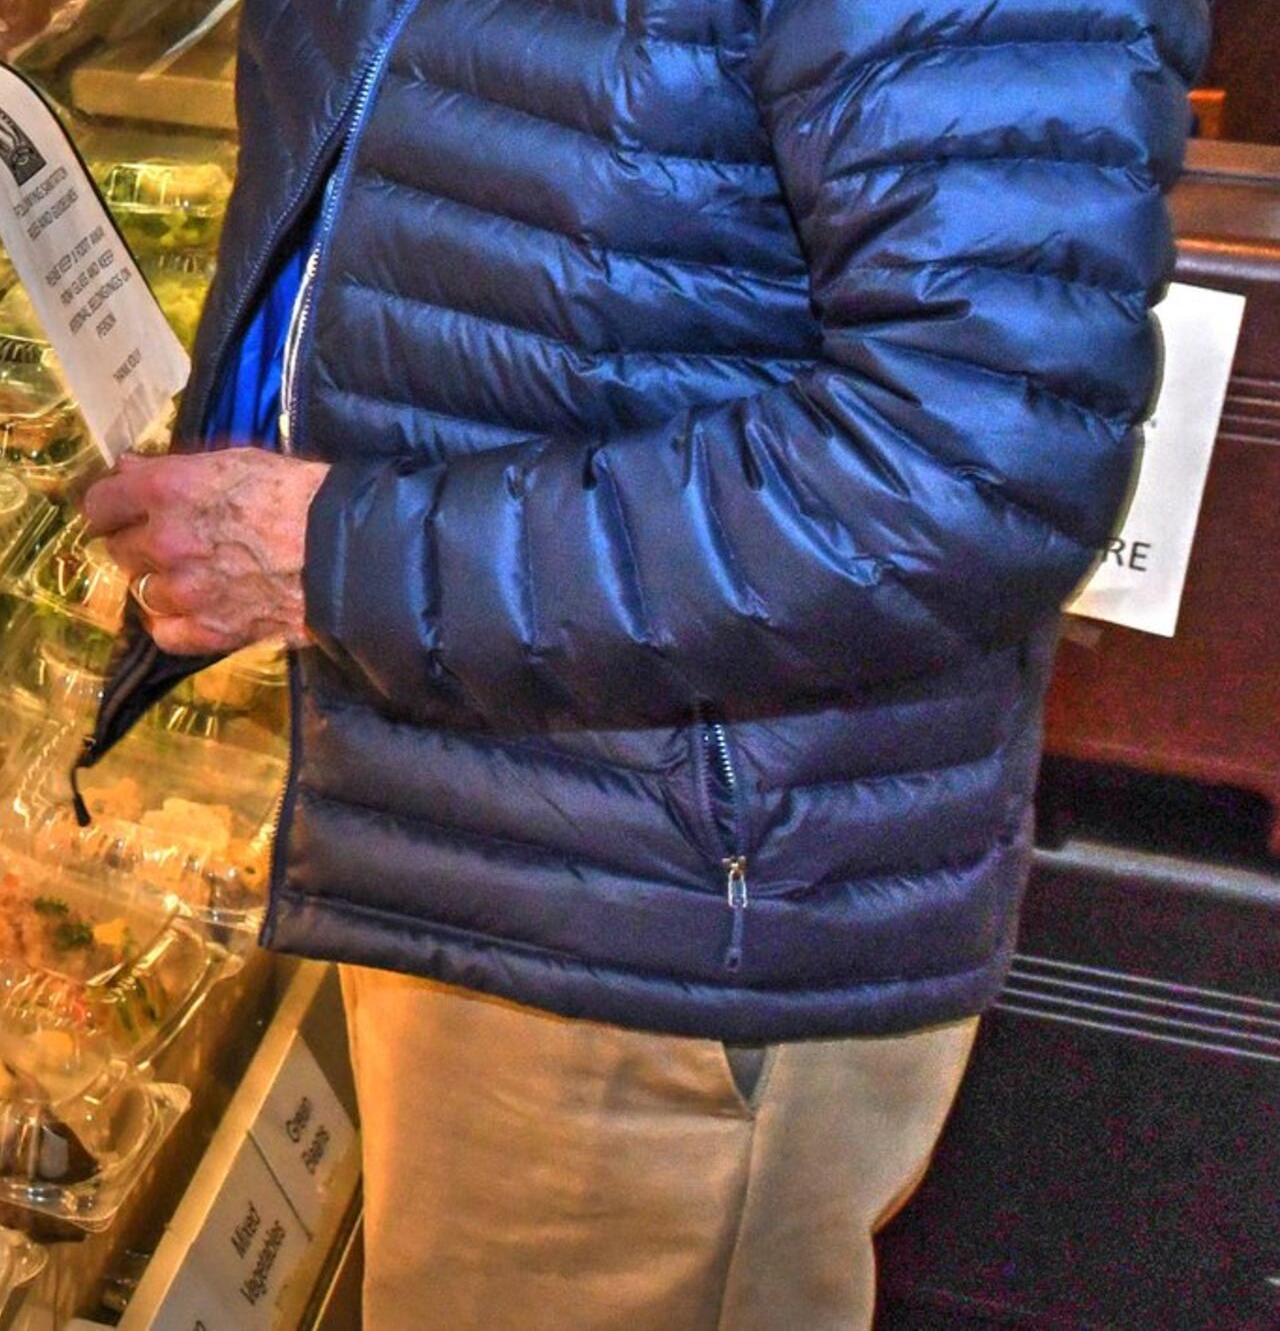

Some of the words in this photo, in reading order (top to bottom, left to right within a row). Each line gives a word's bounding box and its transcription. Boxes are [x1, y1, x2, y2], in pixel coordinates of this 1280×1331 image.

[285, 1096, 311, 1144] Green
[231, 1200, 260, 1260] Mixed
[240, 1220, 286, 1306] Vegetables
